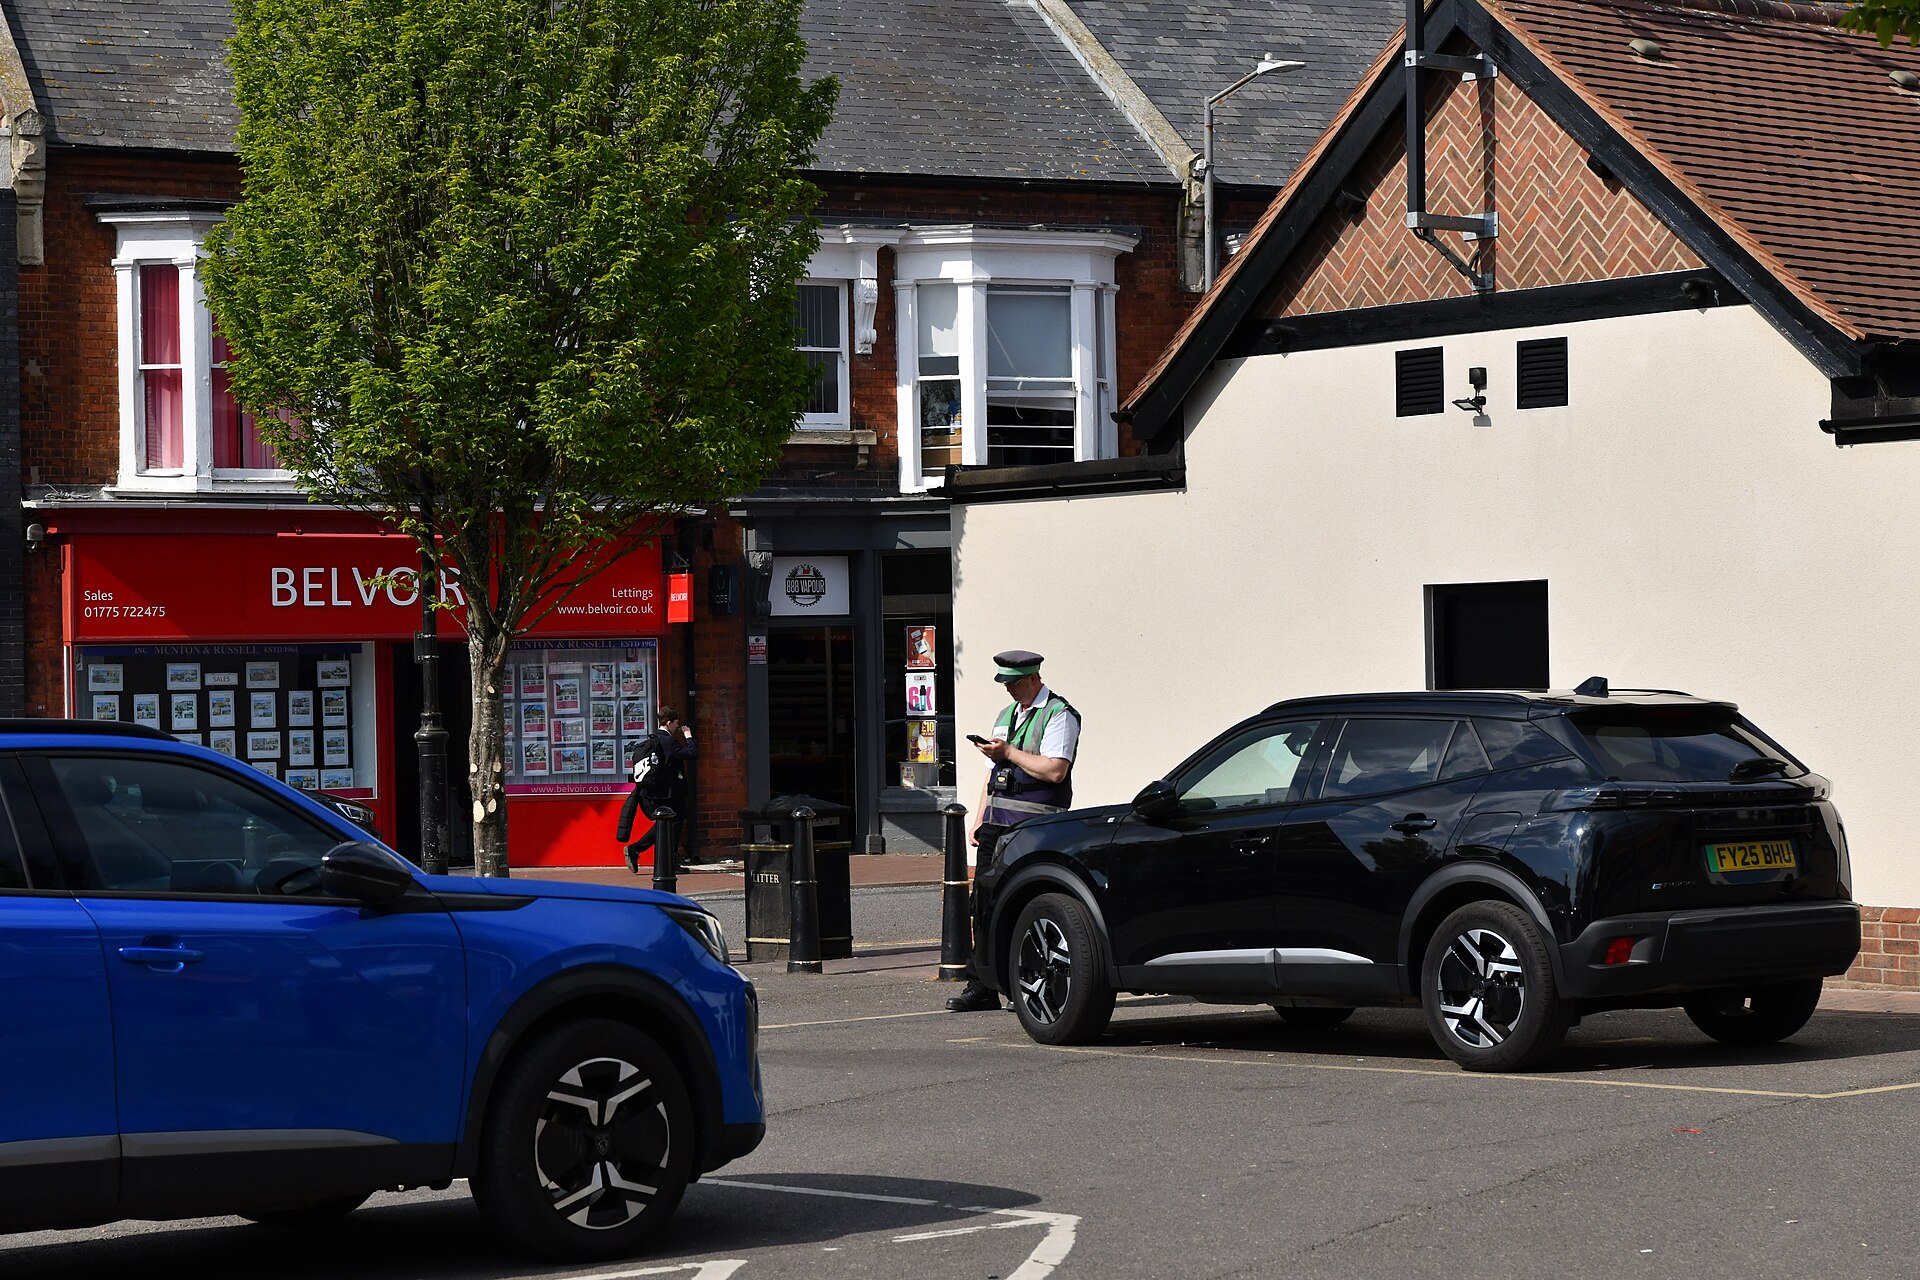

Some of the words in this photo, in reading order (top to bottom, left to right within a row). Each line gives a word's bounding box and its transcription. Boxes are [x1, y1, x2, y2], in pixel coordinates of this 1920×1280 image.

[271, 566, 465, 607] BELVOR
[786, 579, 800, 593] 888
[800, 579, 825, 593] VAPOUR
[84, 589, 113, 601] Sales
[612, 587, 653, 601] Lettings
[84, 606, 120, 618] 01775
[122, 606, 166, 618] 722475
[557, 603, 654, 614] www.belvoir.co.uk
[134, 646, 149, 654] INC
[154, 646, 201, 655] MUNTON
[214, 645, 259, 655] RUSSELL
[568, 640, 615, 649] RUSSELL
[620, 640, 640, 648] ESTD
[641, 640, 656, 648] 1964
[212, 675, 231, 683] SALES
[921, 720, 935, 733] £10
[633, 757, 651, 775] NIKE
[530, 784, 613, 793] www.belvoir.co.uk
[1716, 845, 1760, 868] FY25
[1762, 843, 1792, 865] BHU
[752, 872, 780, 884] LITTER
